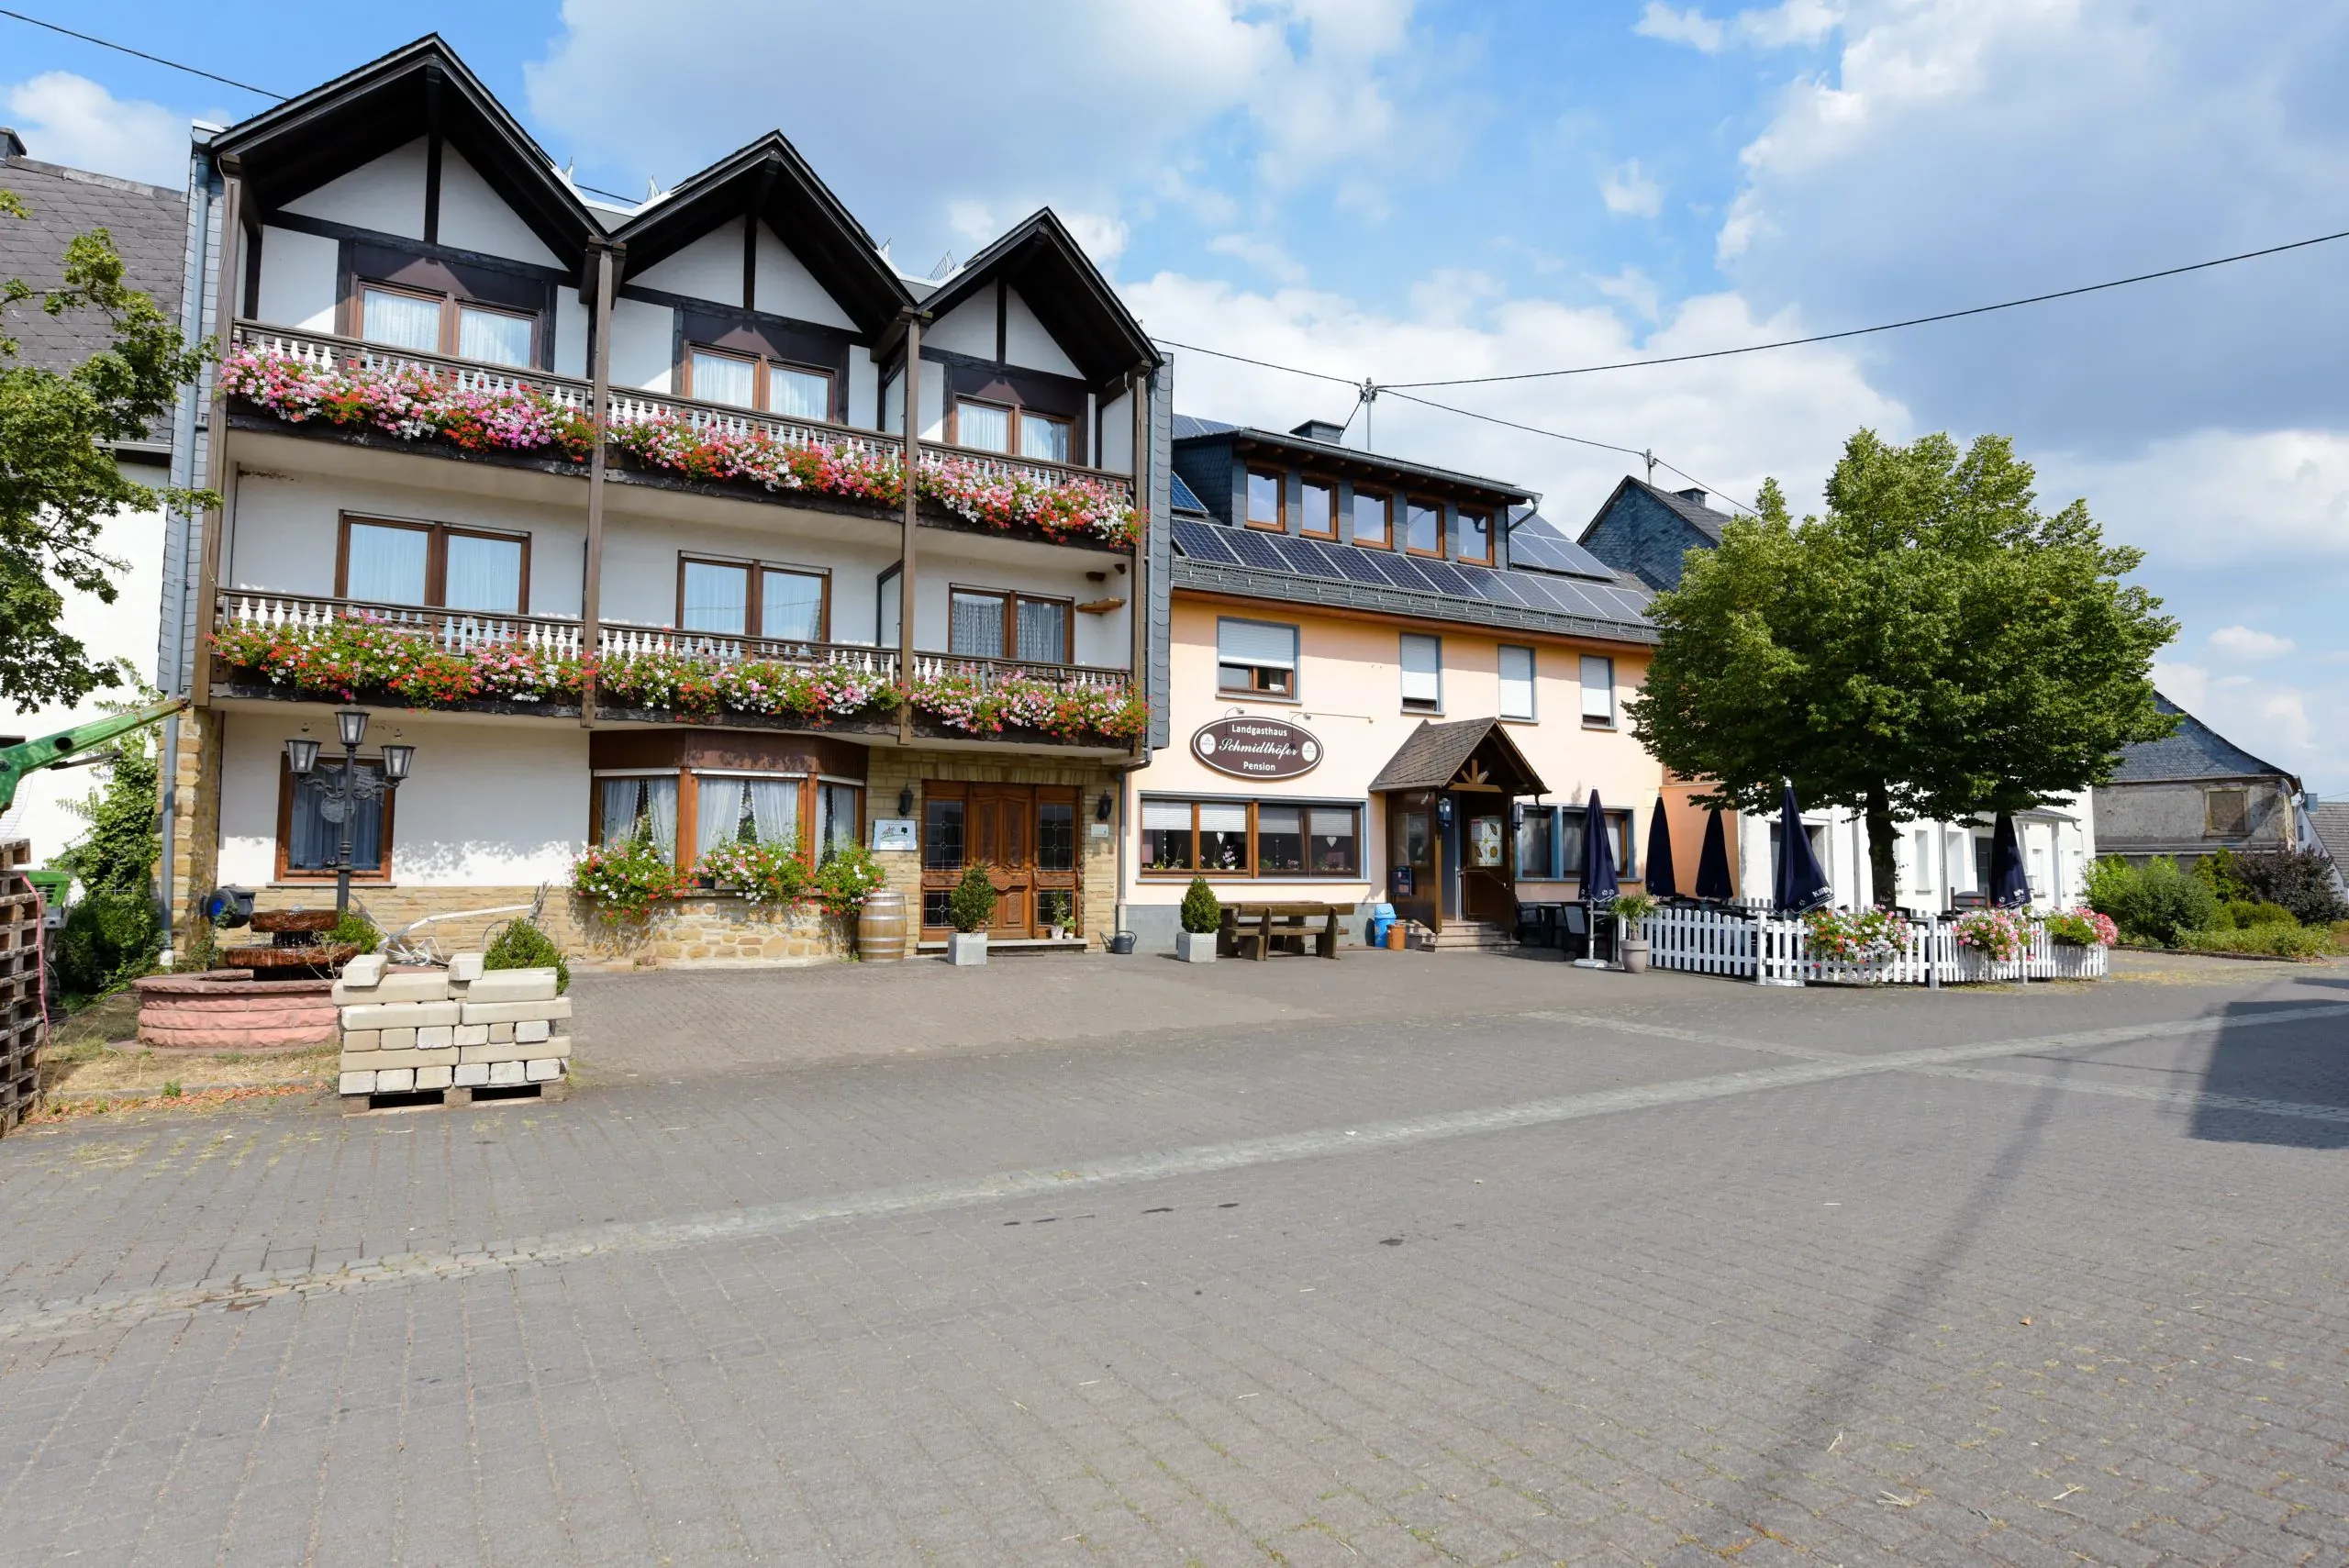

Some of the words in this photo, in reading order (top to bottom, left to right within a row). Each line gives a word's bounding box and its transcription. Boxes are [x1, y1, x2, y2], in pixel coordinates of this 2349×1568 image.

[1231, 724, 1287, 737] Landgasthaus
[1219, 738, 1299, 760] Schmidthöfer
[1243, 761, 1275, 772] Pension
